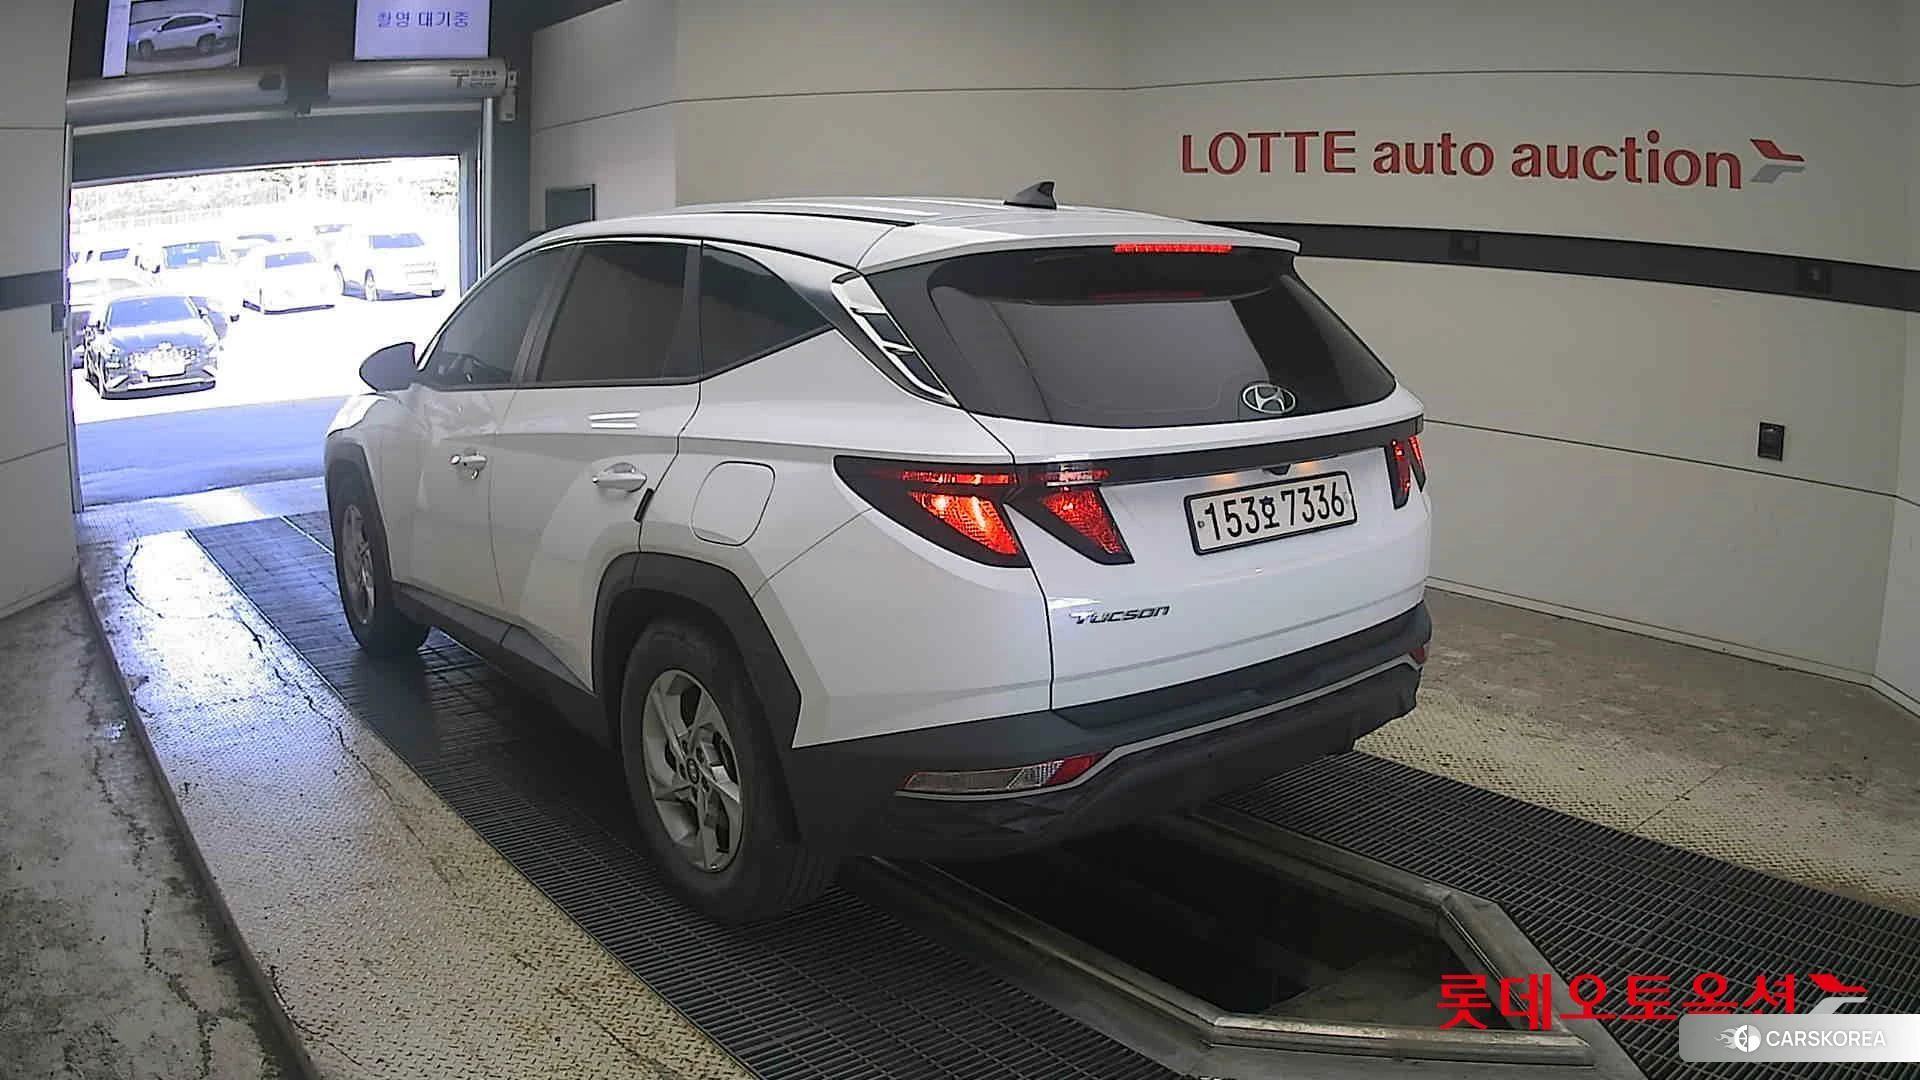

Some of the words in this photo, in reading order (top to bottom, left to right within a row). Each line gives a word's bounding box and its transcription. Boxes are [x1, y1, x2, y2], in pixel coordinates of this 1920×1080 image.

[418, 11, 470, 28] 대기중
[1181, 130, 1356, 175] LOTTE
[1372, 132, 1495, 177] auto
[1510, 129, 1742, 190] auction
[1069, 605, 1170, 625] TUCSON
